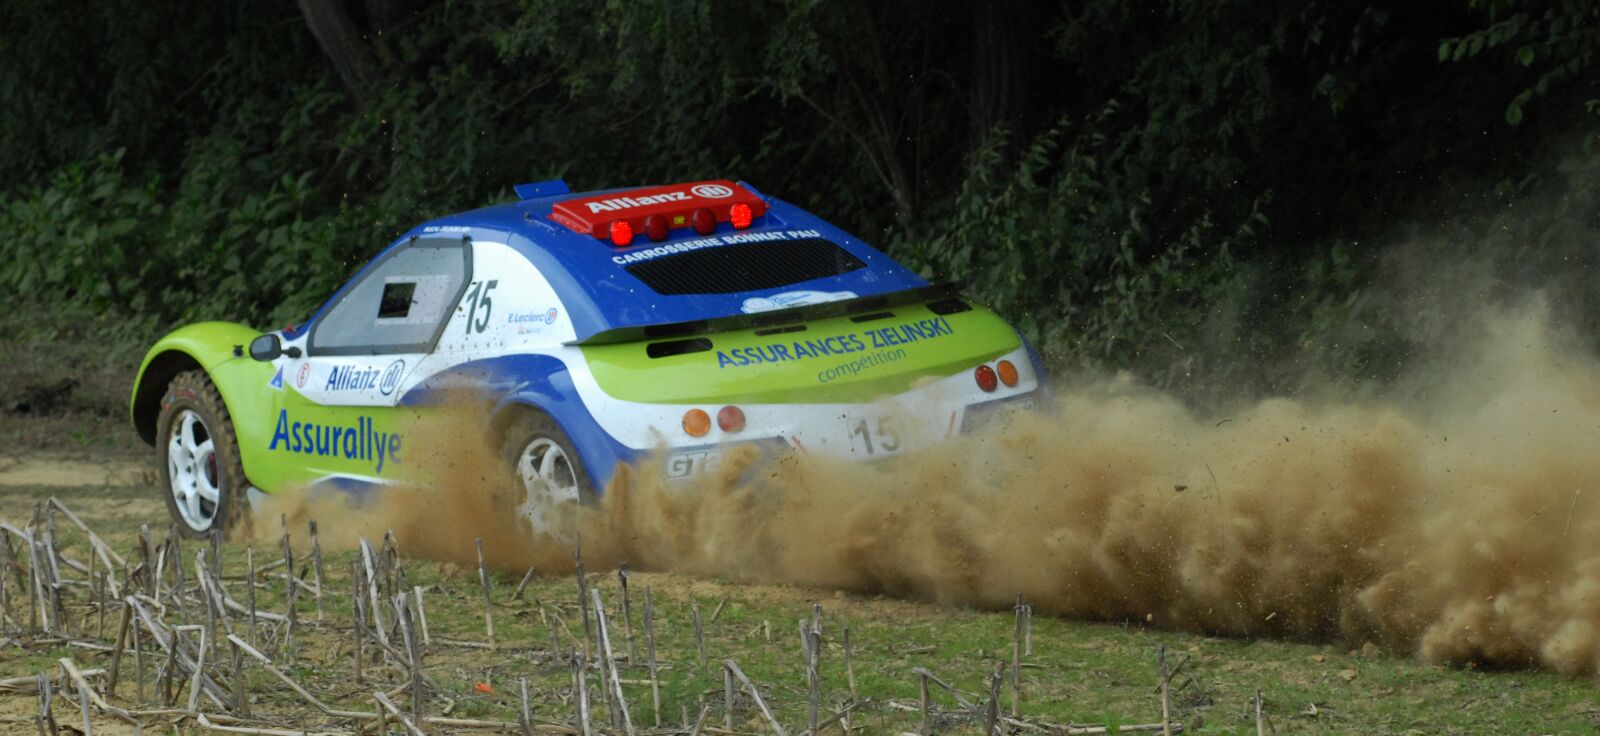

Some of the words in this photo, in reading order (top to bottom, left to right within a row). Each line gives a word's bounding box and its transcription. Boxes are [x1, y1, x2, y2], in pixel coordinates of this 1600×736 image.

[584, 190, 693, 214] Allianz
[612, 236, 721, 265] CARROSSERIE
[721, 230, 784, 246] BONNAT
[786, 228, 821, 239] PAU
[466, 279, 499, 335] 15
[716, 333, 866, 369] ASSURANCES
[864, 316, 954, 348] ZIELINSKI
[325, 365, 381, 392] Allianz
[817, 348, 907, 383] compétition
[268, 408, 402, 475] Assurallye
[853, 415, 900, 455] 15
